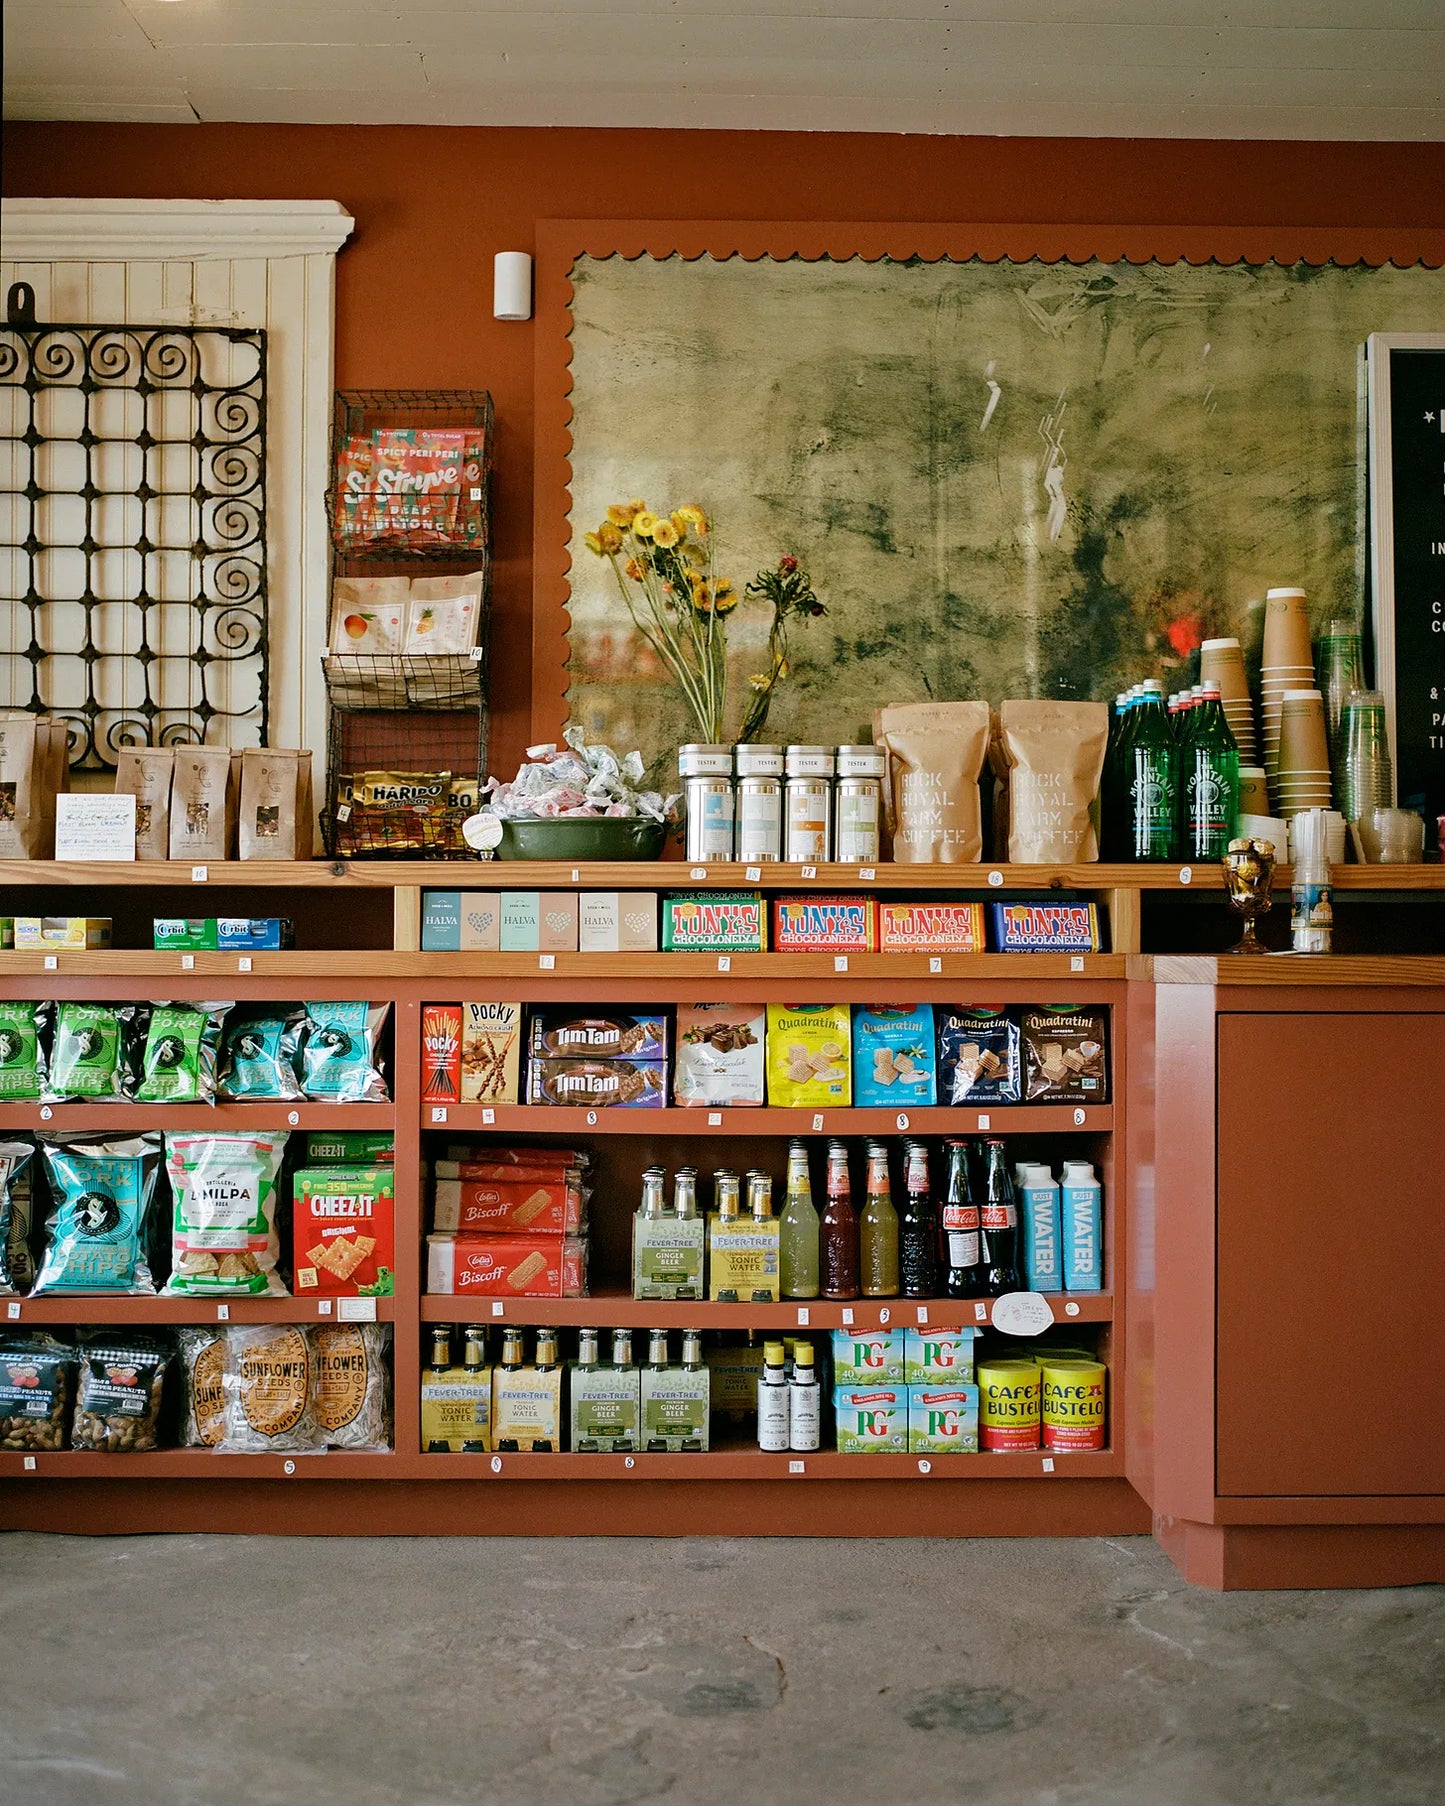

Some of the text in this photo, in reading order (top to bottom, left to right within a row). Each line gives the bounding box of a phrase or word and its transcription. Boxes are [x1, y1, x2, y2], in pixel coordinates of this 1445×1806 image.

[377, 448, 459, 460] SPICY PERI PERI
[375, 467, 458, 503] Stryve
[447, 793, 473, 808] BO
[426, 916, 459, 925] HALVA
[503, 916, 537, 925] HALVA
[583, 917, 615, 926] HALVA
[671, 903, 760, 937] TONY'S
[779, 903, 865, 937] TONY'S
[884, 907, 971, 937] TONY'S
[1003, 906, 1090, 936] TONY'S
[949, 1015, 1010, 1030] Quadratini
[1030, 1015, 1093, 1030] Quadratini
[589, 1112, 597, 1124] 8
[899, 1113, 907, 1127] 8
[465, 1202, 511, 1221] Biscoff
[1033, 1200, 1055, 1274] WATER
[1072, 1199, 1094, 1273] WATER
[656, 1252, 685, 1260] GINGER
[730, 1256, 761, 1264] TONIC
[729, 1263, 761, 1272] WATER
[458, 1265, 505, 1286] Biscoff
[881, 1310, 889, 1323] 3
[977, 1303, 986, 1318] 3
[852, 1341, 885, 1368] PG
[923, 1341, 955, 1368] PG
[243, 1361, 307, 1380] SUNFLOWER
[21, 1388, 53, 1396] PEANUTS
[440, 1407, 472, 1415] TONIC
[511, 1410, 538, 1418] WATER
[1043, 1400, 1104, 1417] BUSTELO
[439, 1414, 472, 1423] WATER
[856, 1410, 889, 1436] PG
[928, 1410, 960, 1436] PG
[285, 1462, 294, 1473] 5
[626, 1457, 634, 1468] 8
[921, 1460, 929, 1470] 9
